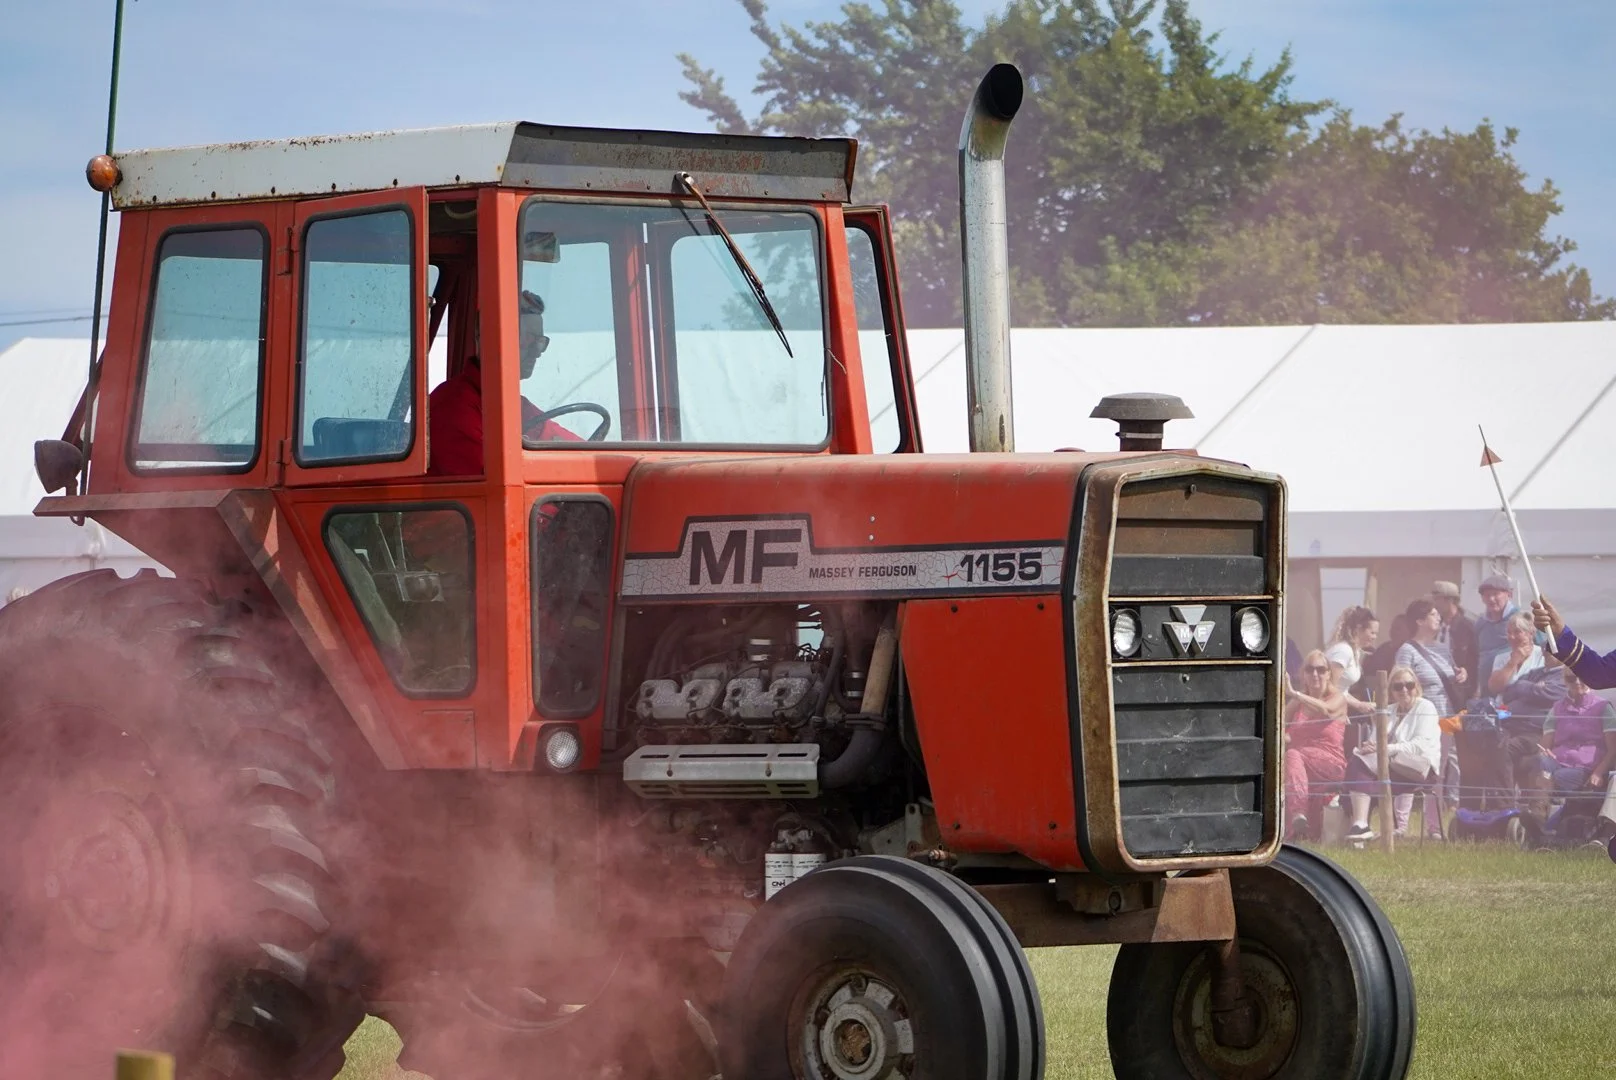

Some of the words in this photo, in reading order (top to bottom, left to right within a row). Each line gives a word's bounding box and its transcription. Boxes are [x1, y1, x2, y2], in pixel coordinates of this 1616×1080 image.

[689, 528, 802, 585] MF
[809, 567, 854, 578] MASSEY
[858, 565, 917, 577] FERGUSON
[960, 552, 1042, 582] 1155
